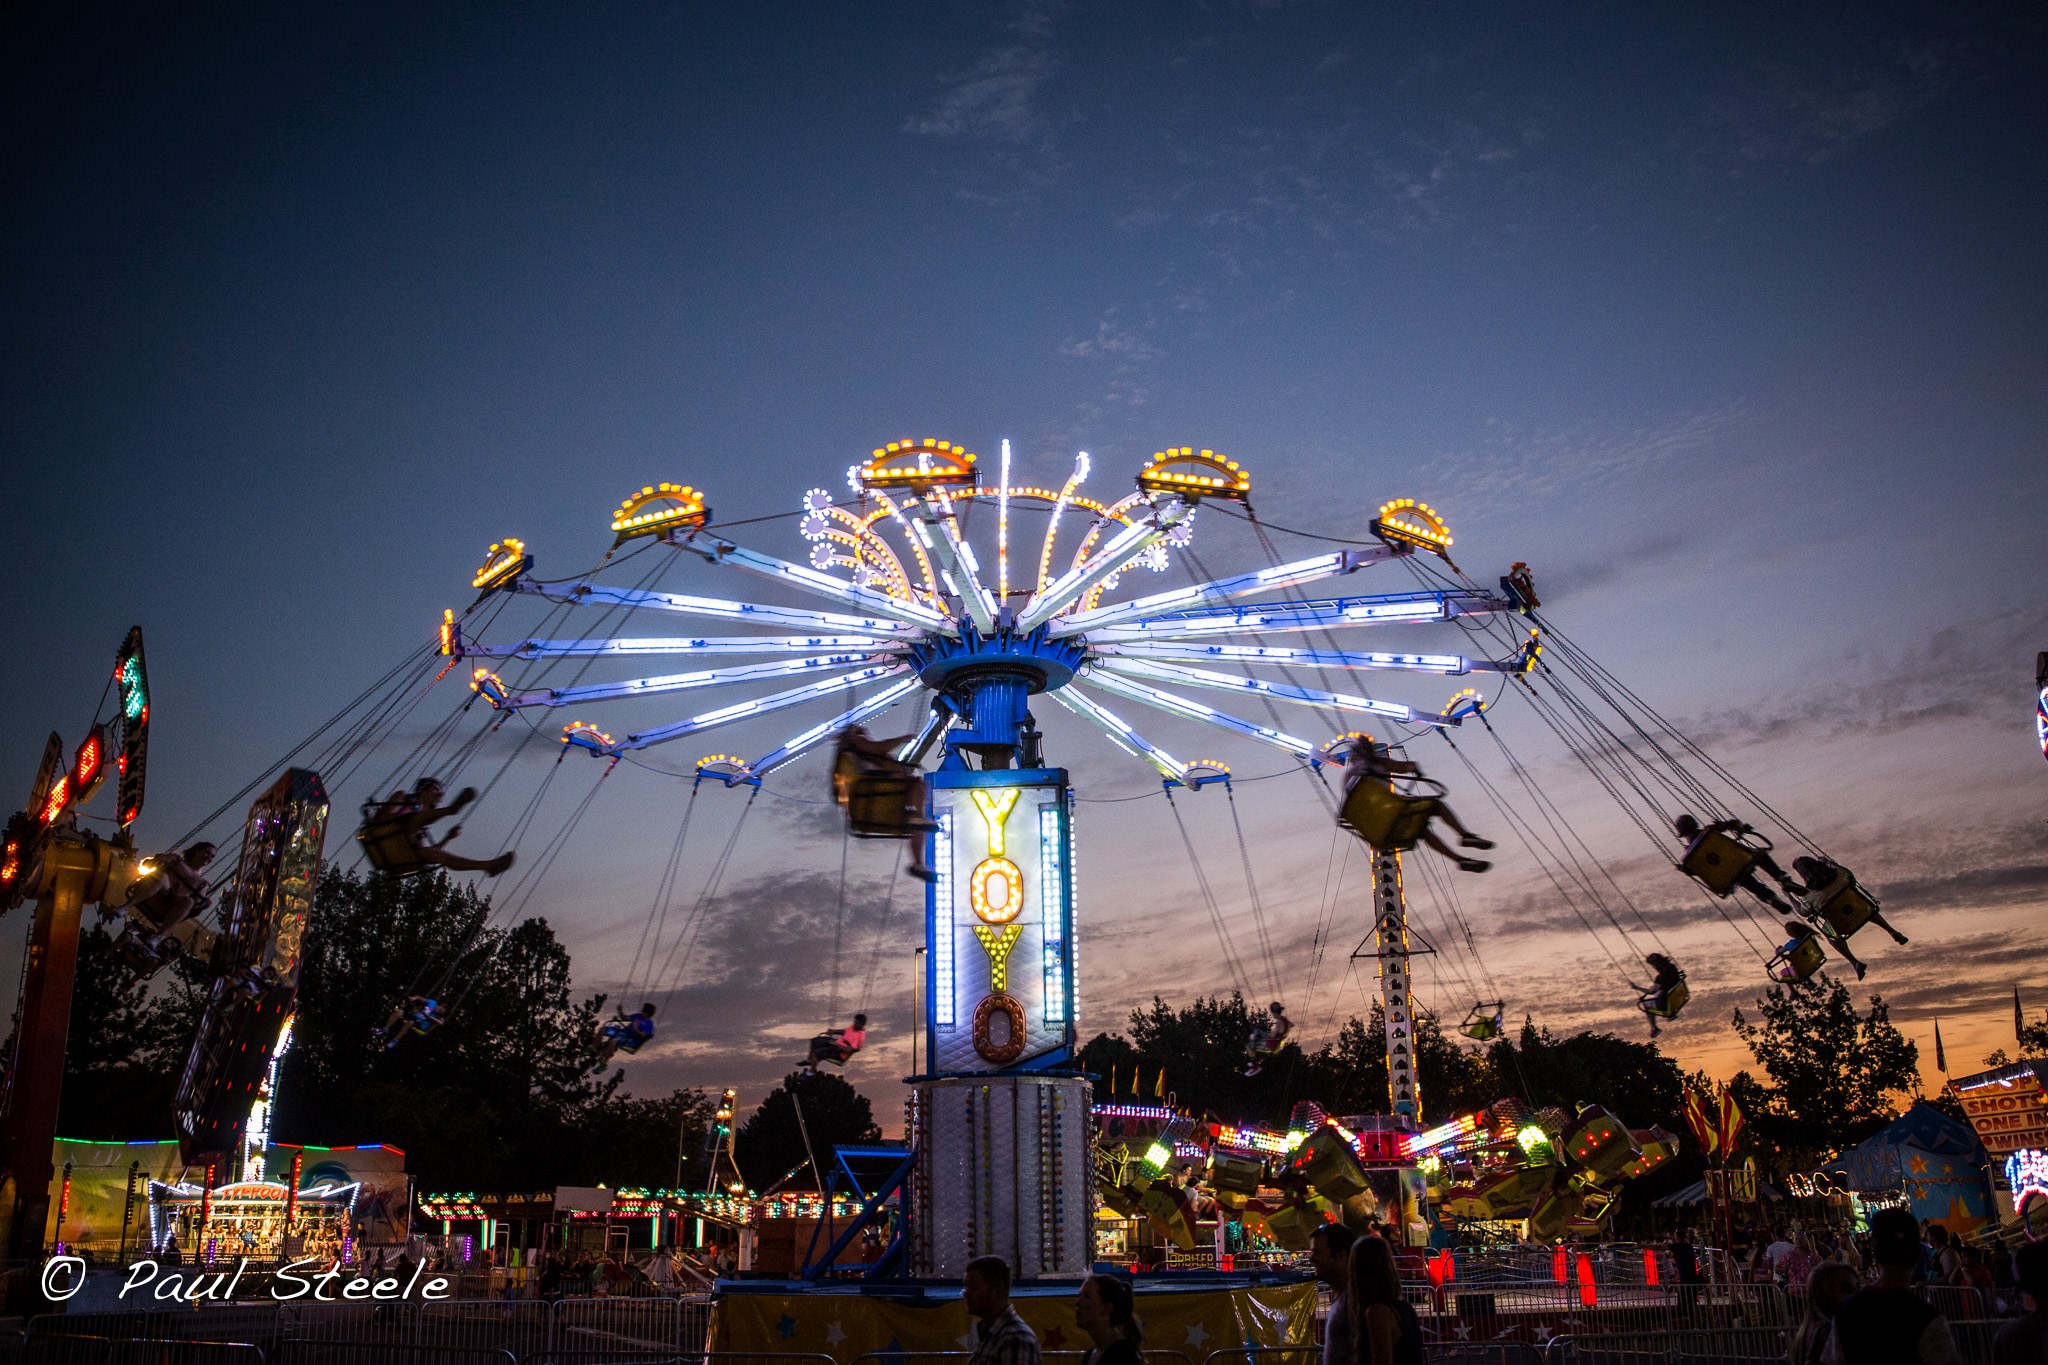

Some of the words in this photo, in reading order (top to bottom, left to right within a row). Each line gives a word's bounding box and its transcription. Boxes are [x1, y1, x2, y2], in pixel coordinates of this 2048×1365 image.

[970, 788, 1027, 1064] YOYO
[1975, 1115, 2022, 1132] ONE
[2026, 1112, 2048, 1127] IN
